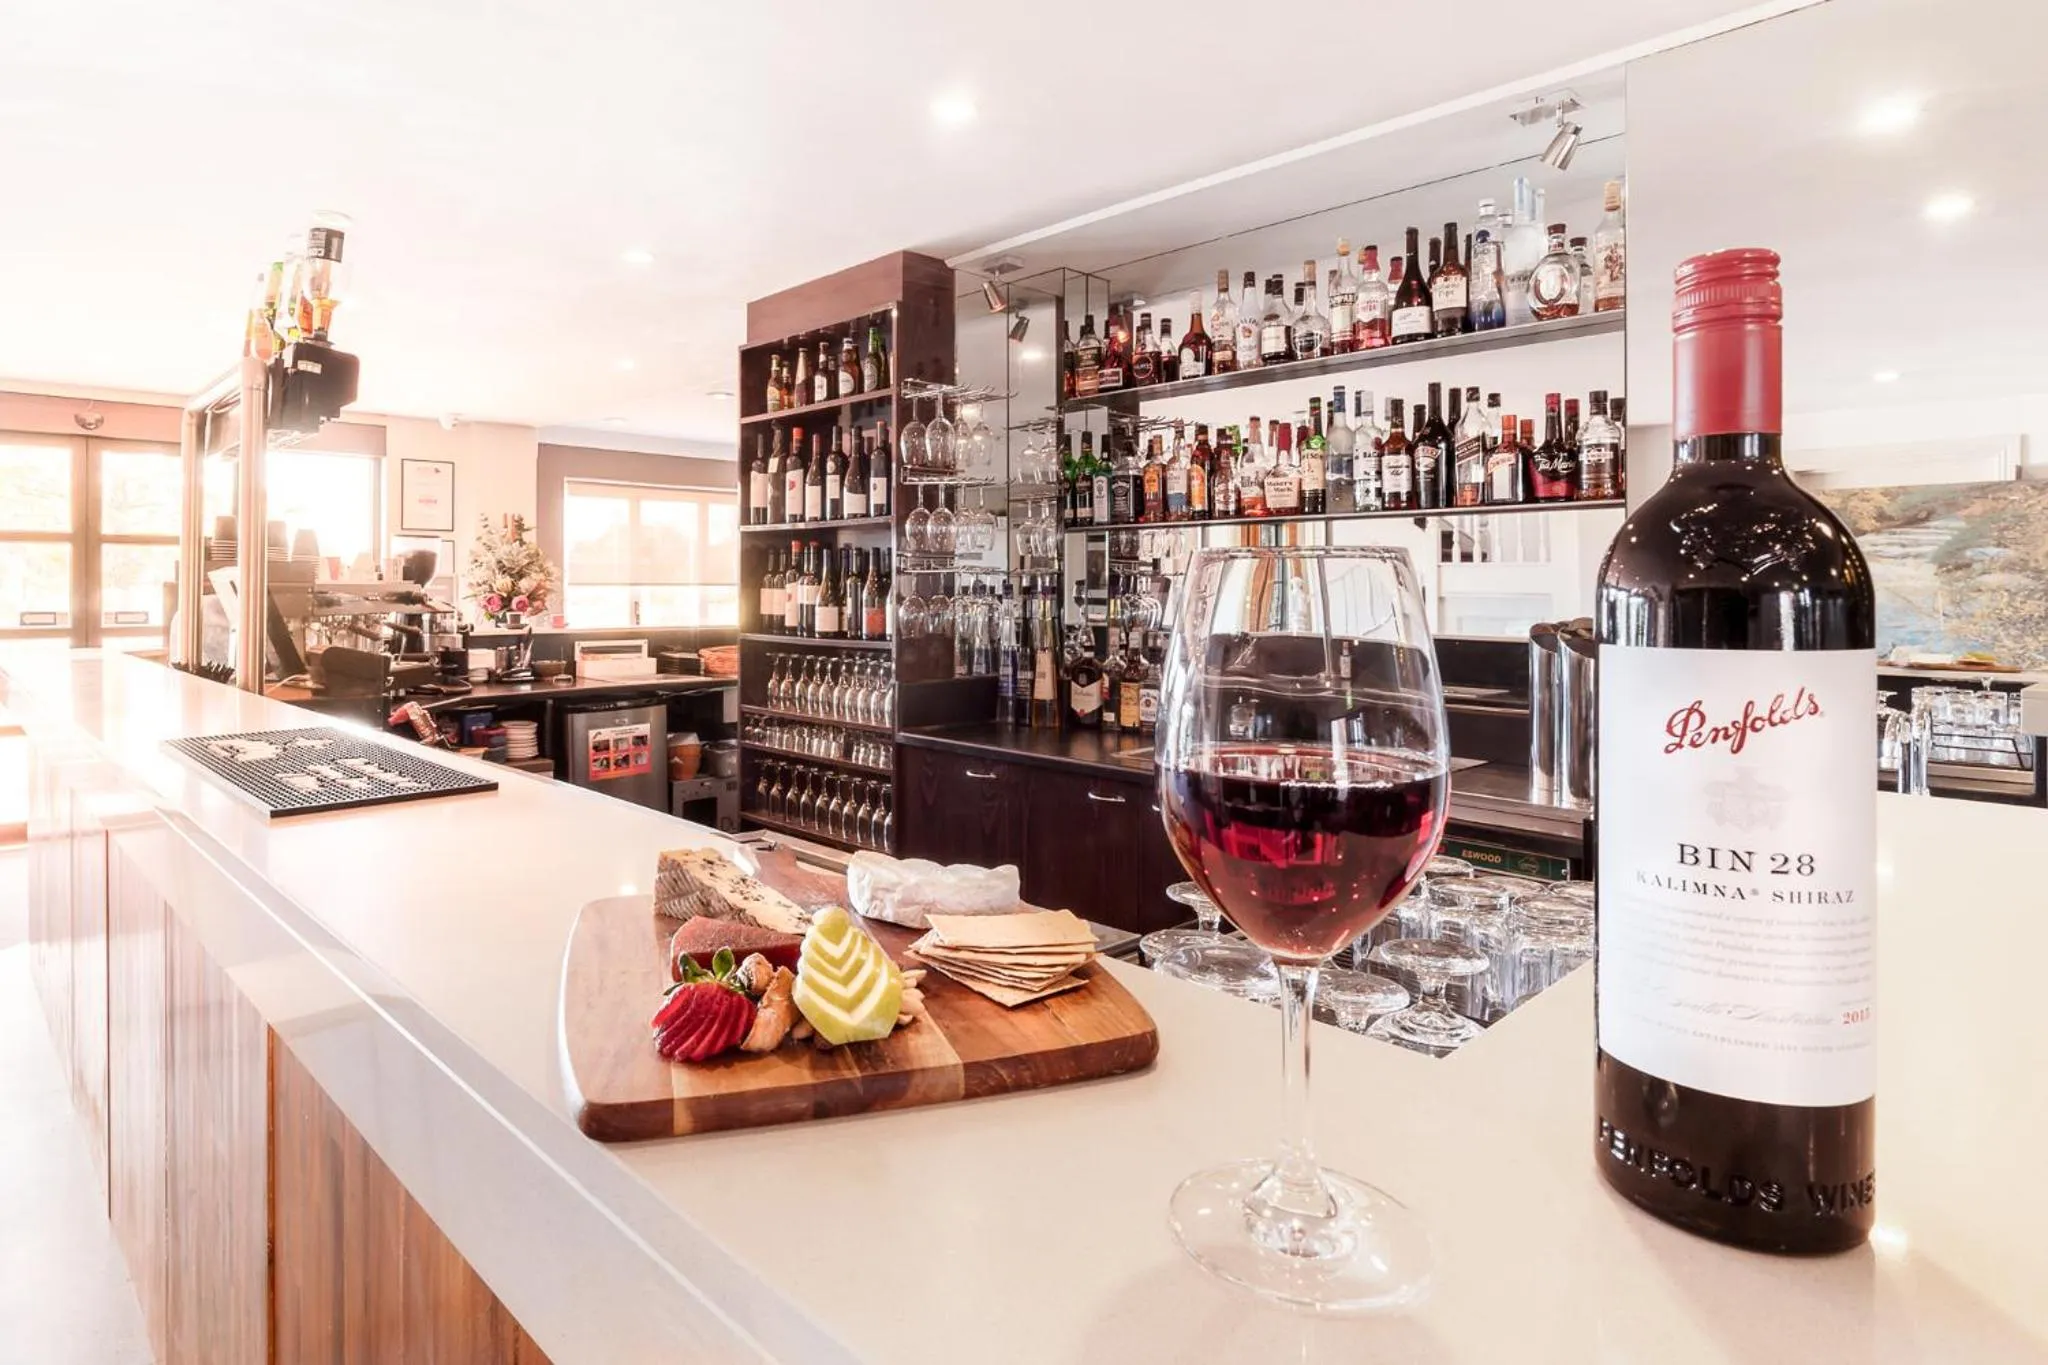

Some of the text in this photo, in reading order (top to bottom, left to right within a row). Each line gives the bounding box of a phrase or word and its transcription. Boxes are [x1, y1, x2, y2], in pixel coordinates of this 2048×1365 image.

[1663, 686, 1820, 755] Penfolds
[1461, 849, 1502, 864] ESWOOD
[1676, 843, 1816, 877] BIN 28
[1771, 890, 1855, 905] SHIRAZ
[1805, 1167, 1876, 1217] WINE
